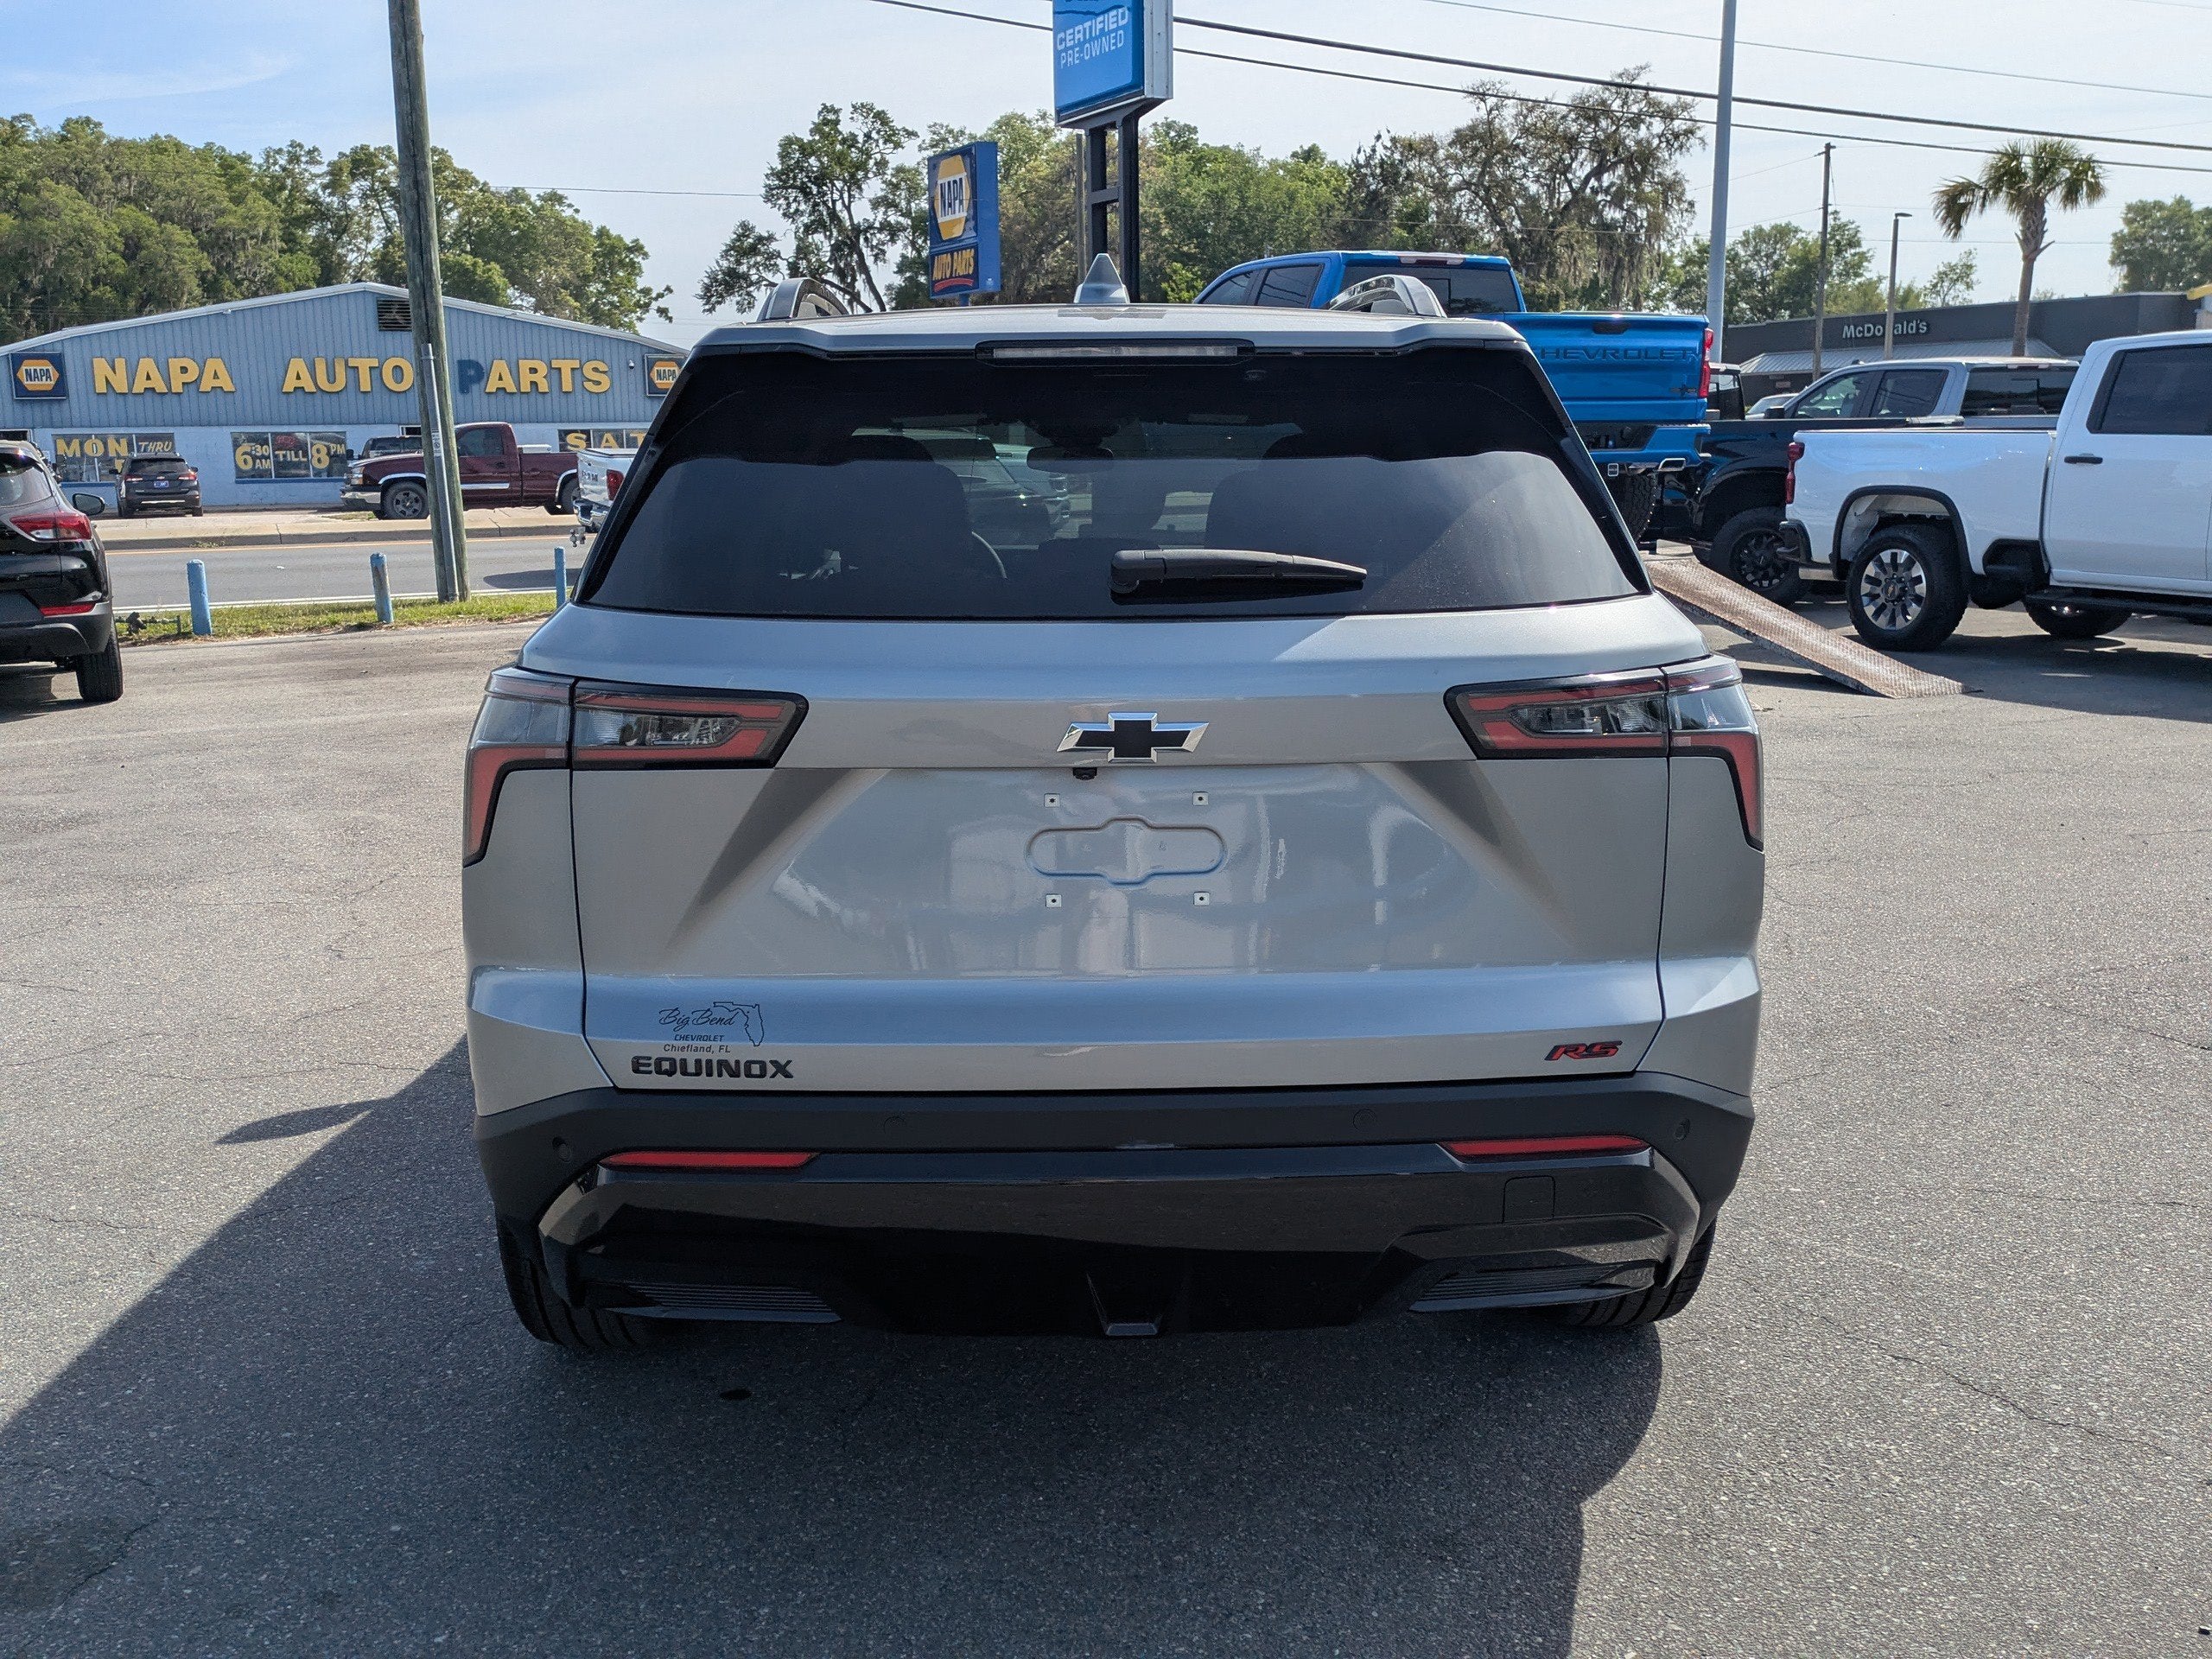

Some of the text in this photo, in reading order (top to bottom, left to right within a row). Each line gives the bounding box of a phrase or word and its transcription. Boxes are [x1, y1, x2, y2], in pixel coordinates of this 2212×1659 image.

[1057, 7, 1128, 50] CERTIFIED
[1060, 30, 1124, 68] PRE-OWNED
[939, 177, 964, 217] NAPA
[933, 248, 975, 281] AUTO PARTS
[1842, 319, 1928, 339] McDoald's
[1533, 347, 1700, 362] HEVROLET
[24, 368, 53, 382] NAPA
[92, 357, 611, 394] NAPA AUTO PARTS
[656, 369, 677, 381] NAPA
[56, 438, 172, 458] MON THRU
[235, 442, 345, 470] 6:30 AM TILL 8 PM
[658, 1007, 736, 1032] Big Bend
[664, 1044, 731, 1054] Chiefland, FL
[1544, 1040, 1623, 1061] RS
[631, 1055, 794, 1079] EQUINOX
